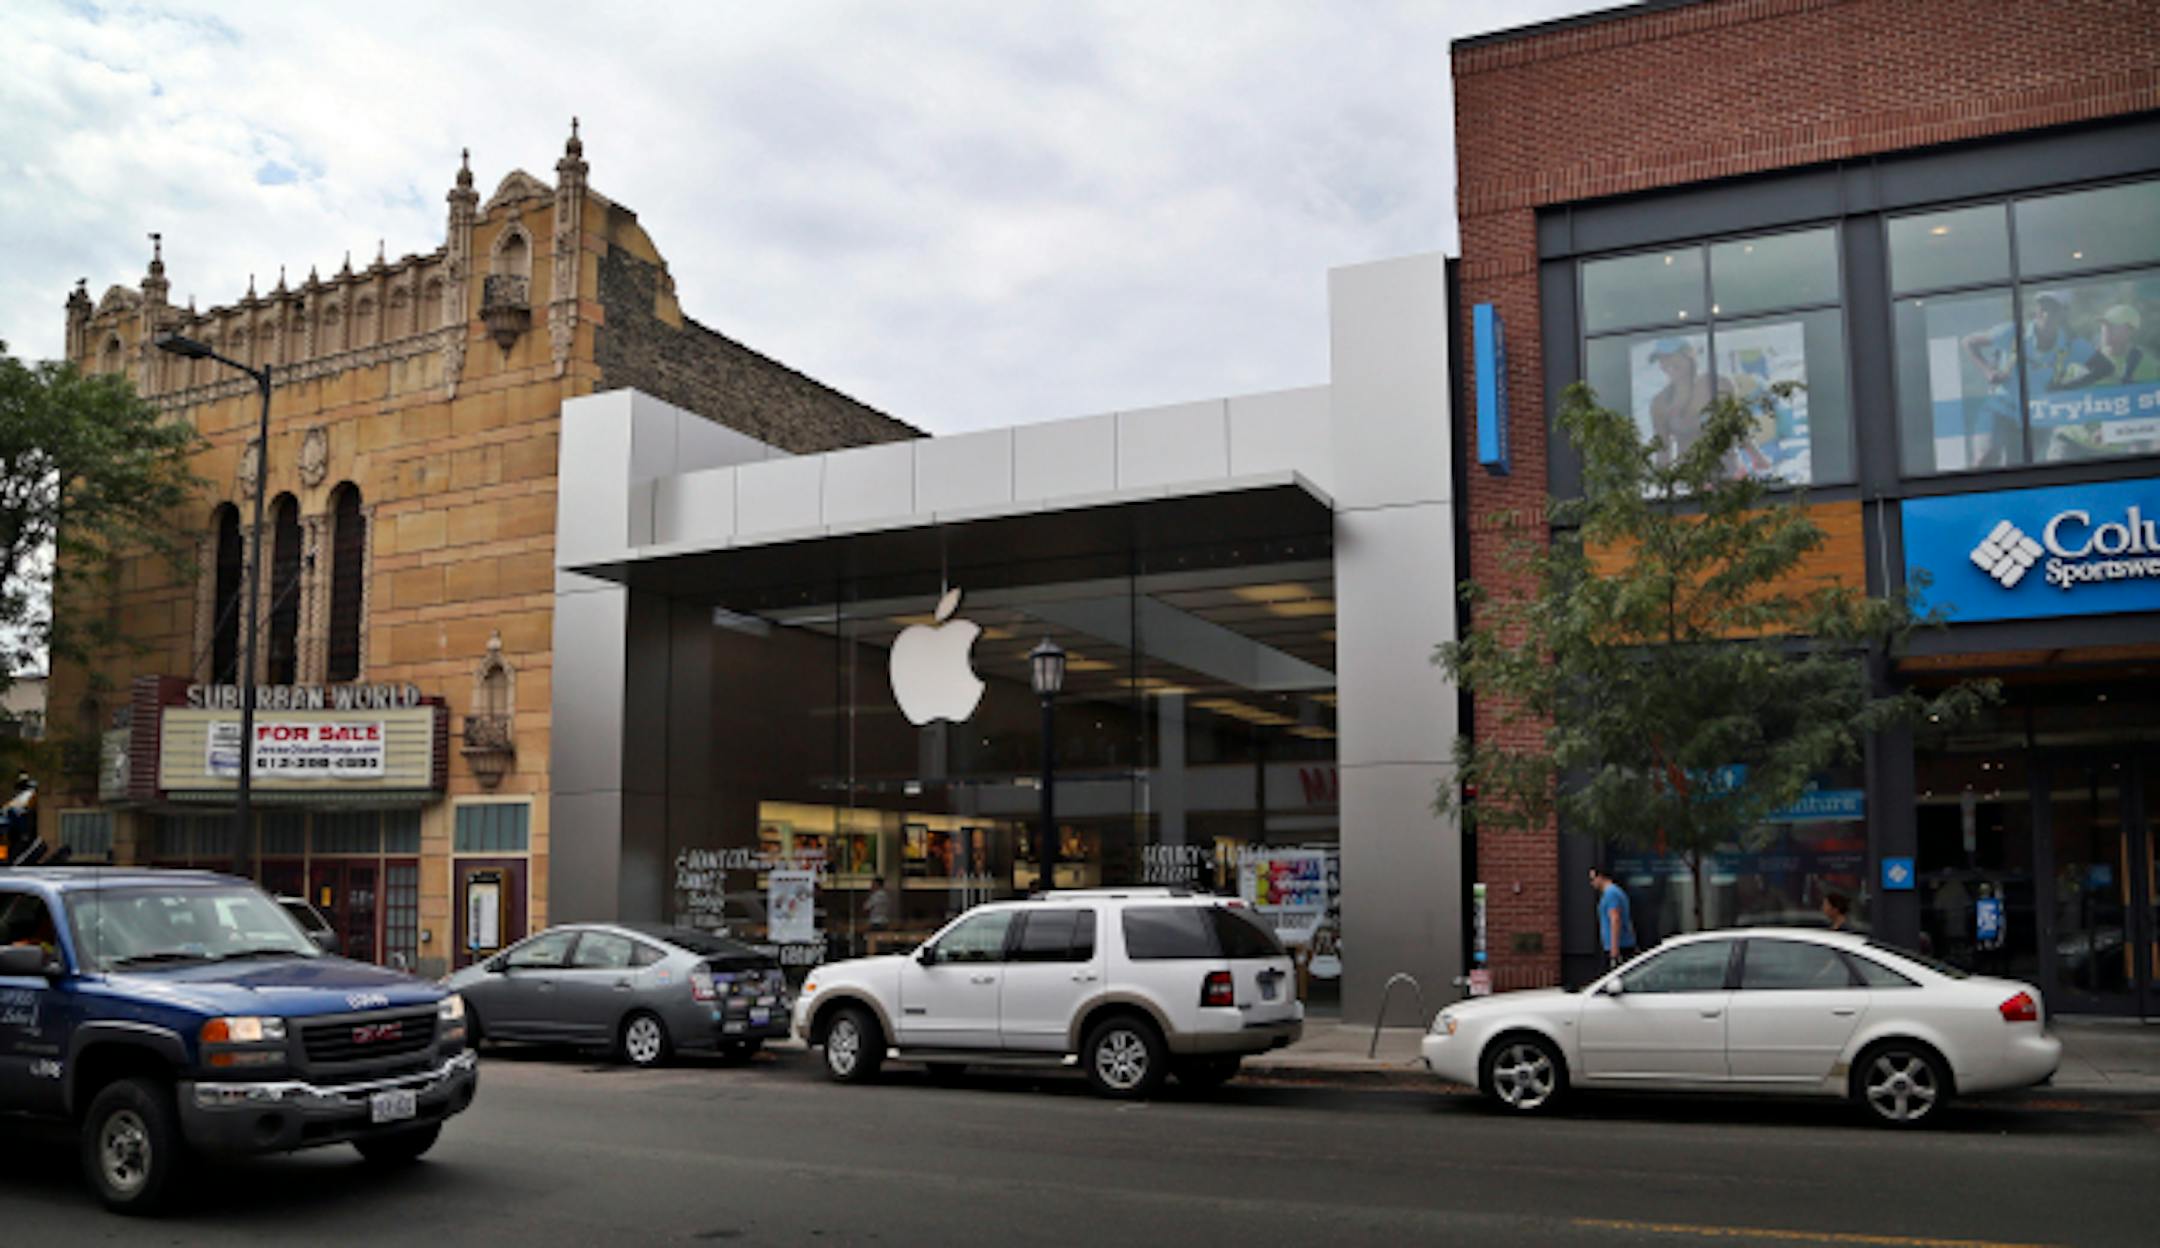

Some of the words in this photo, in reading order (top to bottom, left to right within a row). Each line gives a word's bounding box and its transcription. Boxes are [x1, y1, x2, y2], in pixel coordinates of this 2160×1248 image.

[2029, 393, 2131, 420] Trying
[2042, 505, 2160, 558] Colu
[332, 683, 421, 710] WORLD
[256, 725, 310, 741] FOR
[319, 725, 381, 741] SALE
